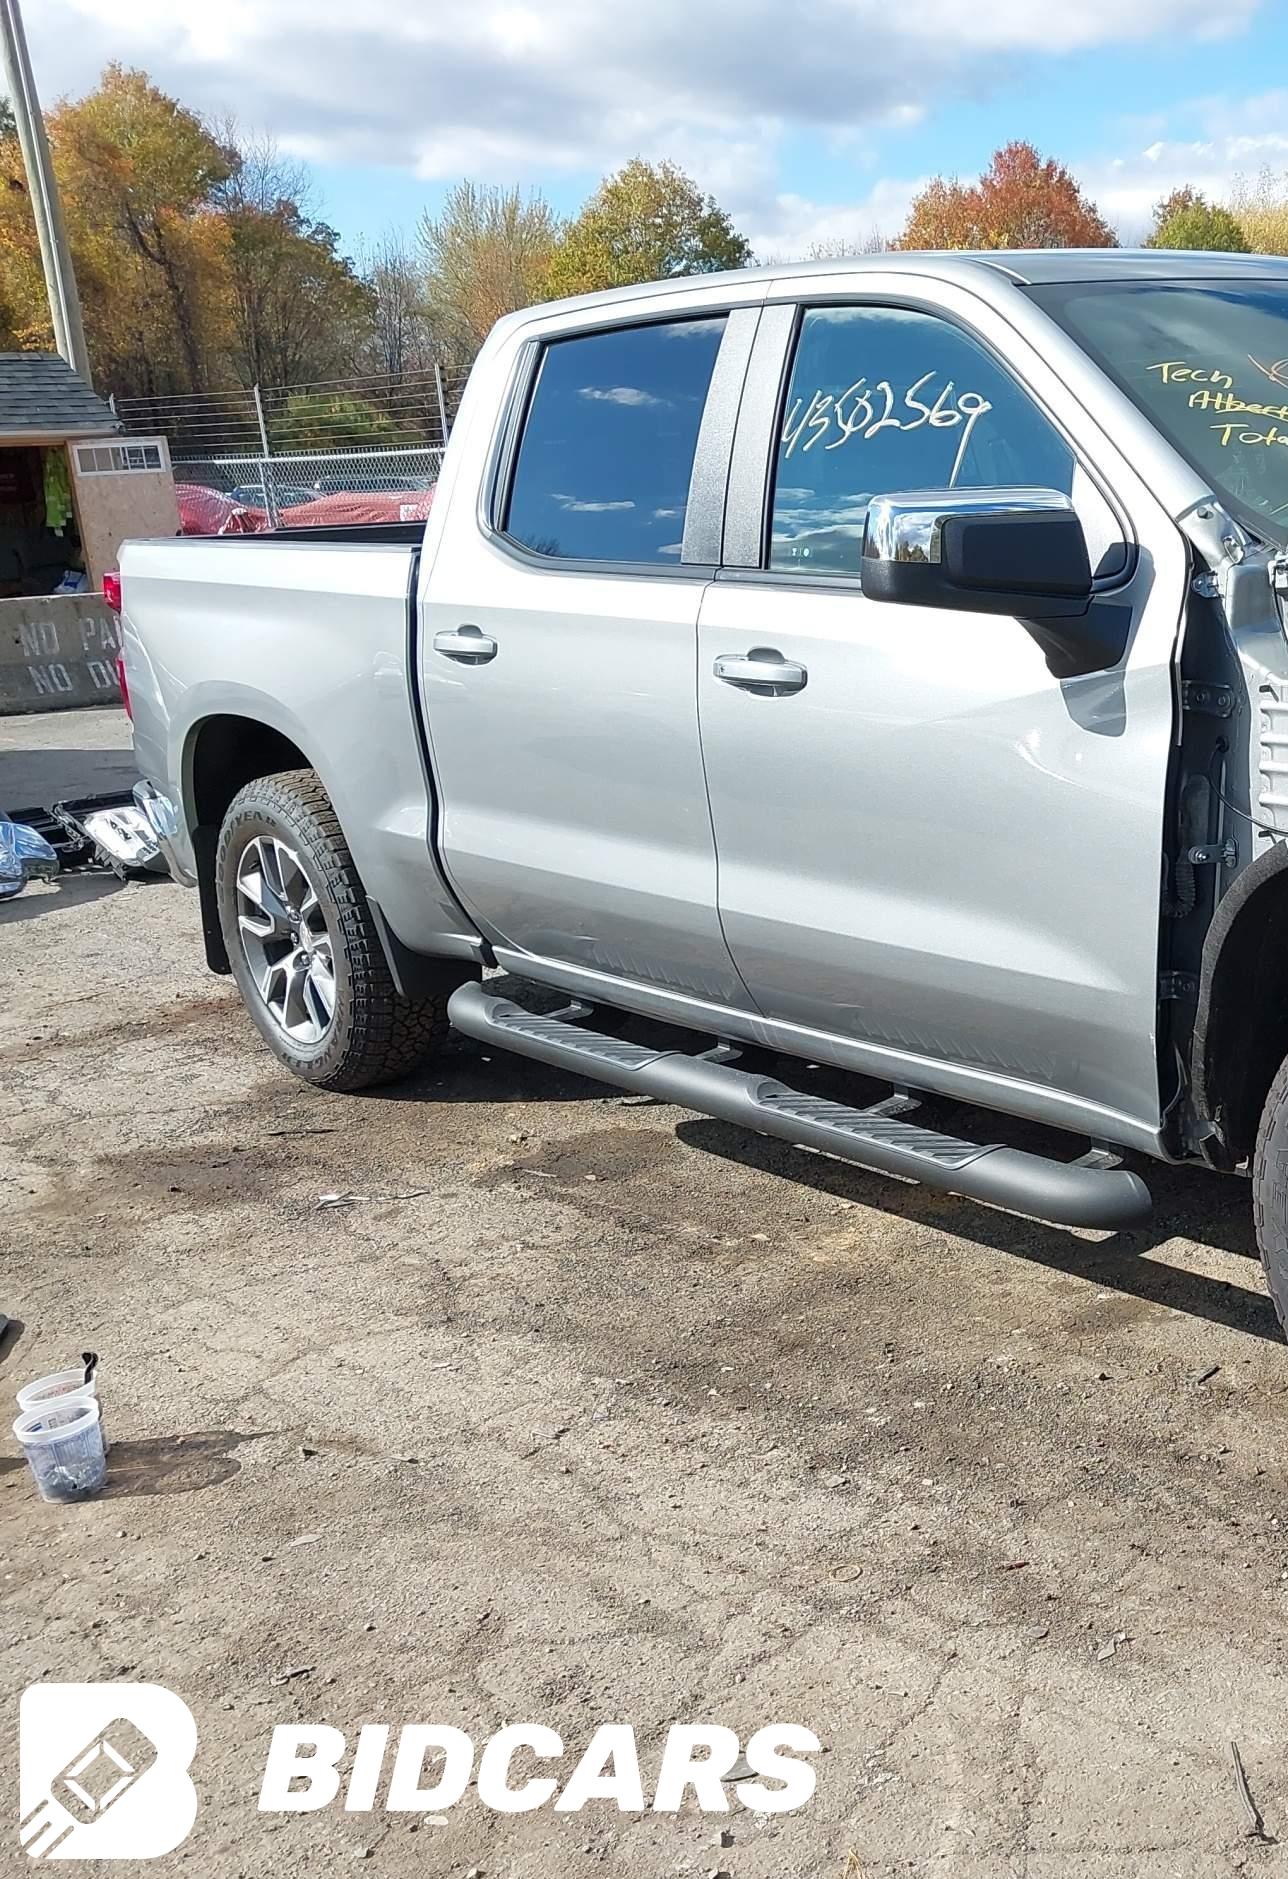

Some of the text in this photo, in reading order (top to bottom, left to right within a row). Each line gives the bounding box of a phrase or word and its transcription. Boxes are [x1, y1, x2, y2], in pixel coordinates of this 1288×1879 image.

[1146, 361, 1232, 388] Tech
[20, 623, 59, 656] NO
[27, 664, 72, 694] NO
